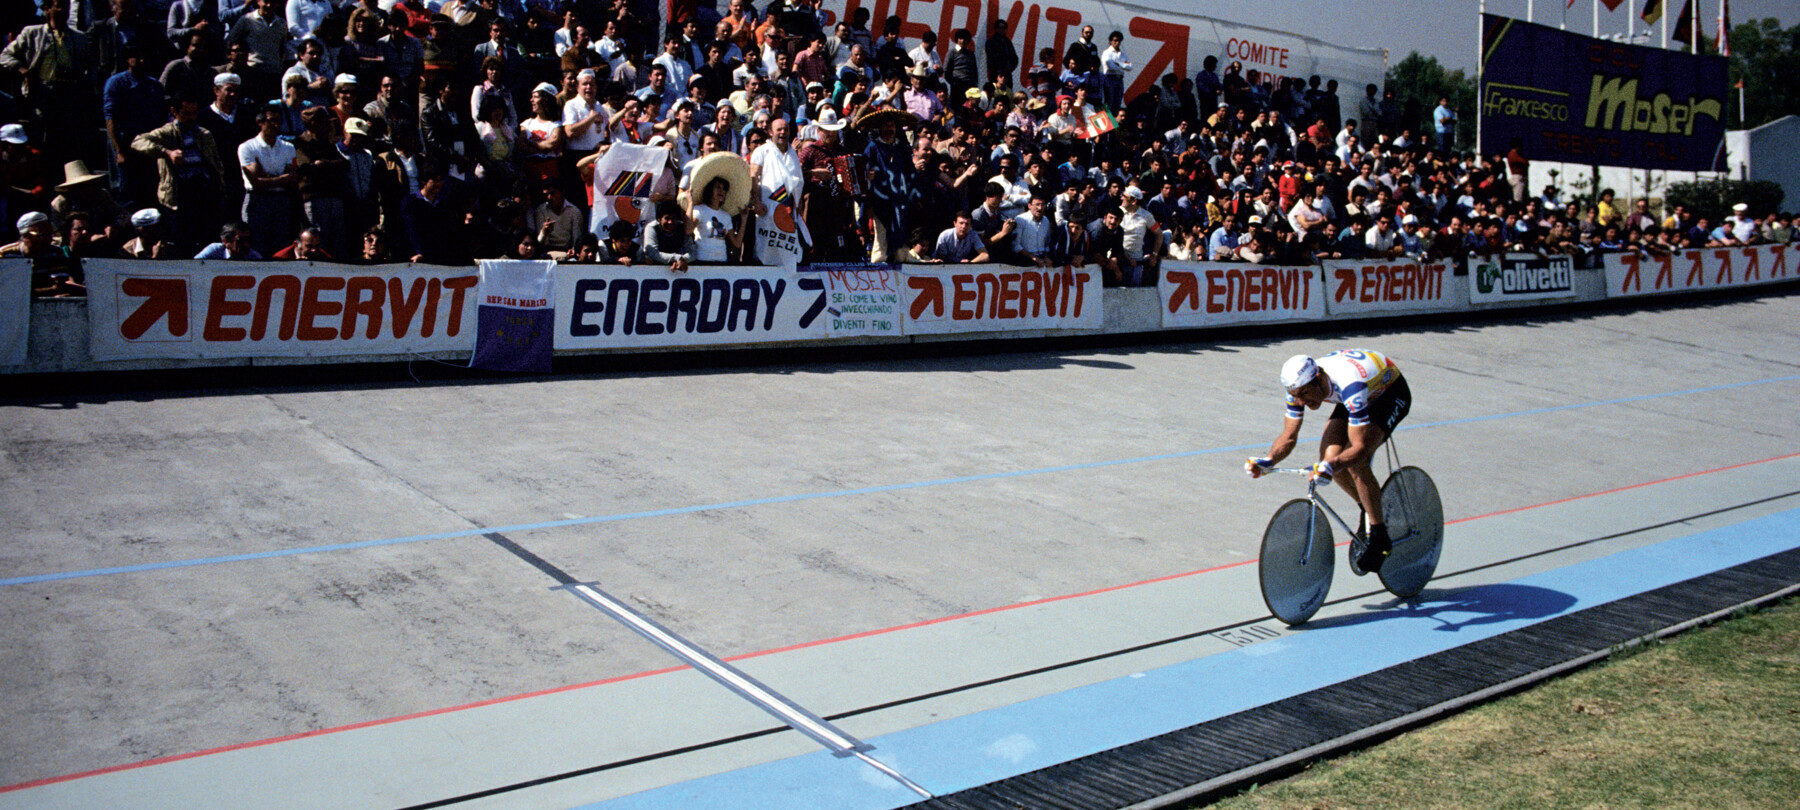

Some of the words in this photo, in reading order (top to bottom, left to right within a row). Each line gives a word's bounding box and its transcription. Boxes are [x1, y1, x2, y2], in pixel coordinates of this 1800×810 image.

[1227, 38, 1289, 68] COMITE
[1589, 43, 1646, 70] CICLI
[1542, 131, 1621, 157] TRENTO
[1642, 141, 1687, 161] ITALY
[759, 228, 796, 244] MOSE
[827, 269, 896, 293] MOSER
[1205, 268, 1313, 313] ENERVIT
[1360, 264, 1447, 303] ENERVIT
[1502, 260, 1569, 292] olivetti
[202, 275, 478, 342] ENERVIT
[570, 278, 786, 337] ENERDAY
[831, 293, 845, 303] SEI
[849, 294, 868, 304] COME
[879, 294, 897, 304] VINO
[841, 305, 892, 314] INVECCHIANDO
[952, 271, 1090, 320] ENERVIT
[833, 319, 865, 330] DIVENTI
[872, 320, 892, 330] FINO
[1218, 625, 1281, 644] 310
